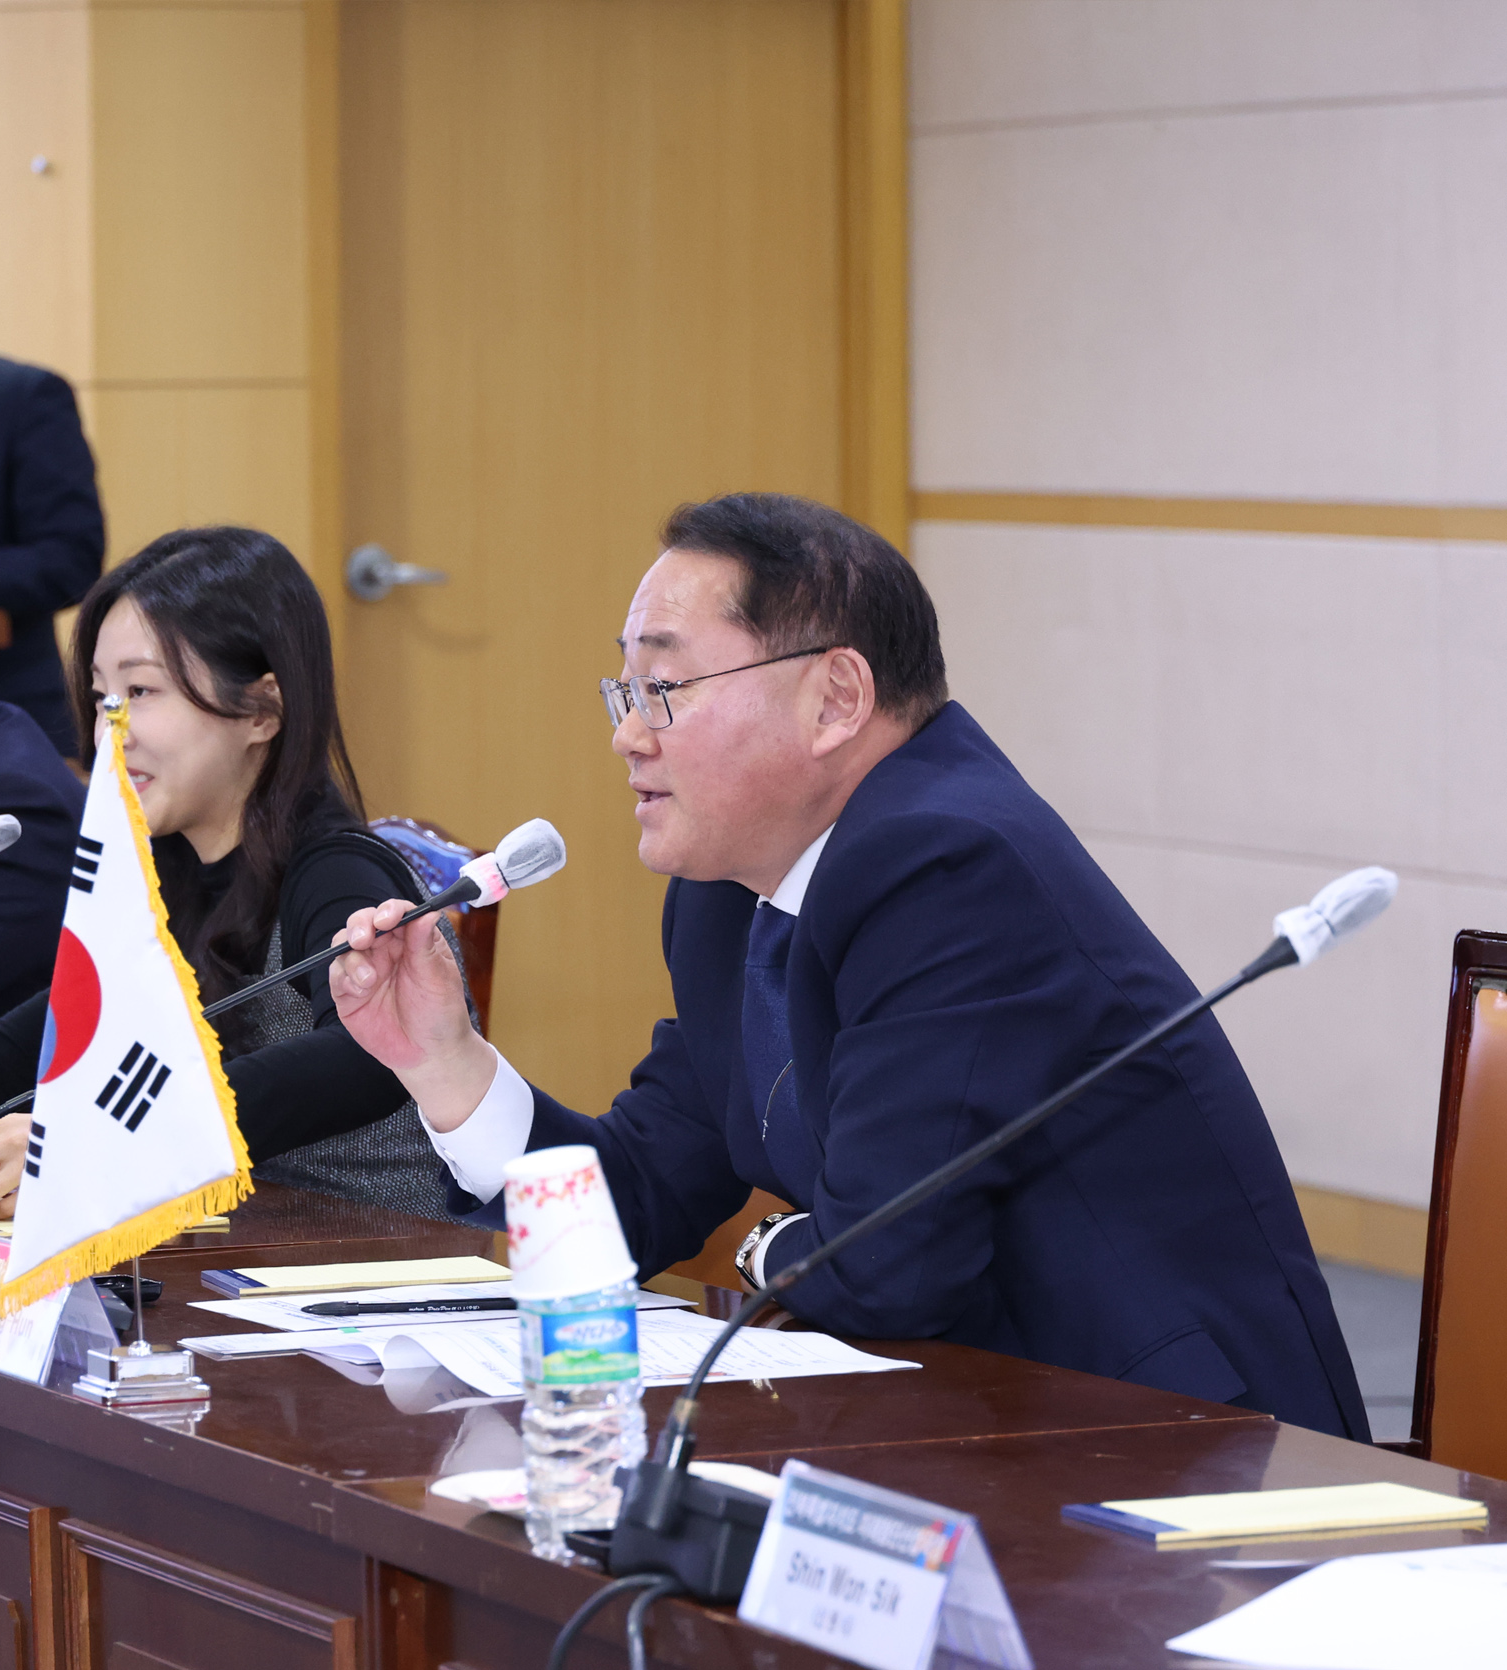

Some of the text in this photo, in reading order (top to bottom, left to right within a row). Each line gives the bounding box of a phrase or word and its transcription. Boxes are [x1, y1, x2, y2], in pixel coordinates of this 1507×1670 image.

[786, 1550, 901, 1617] Shin Won Sik
